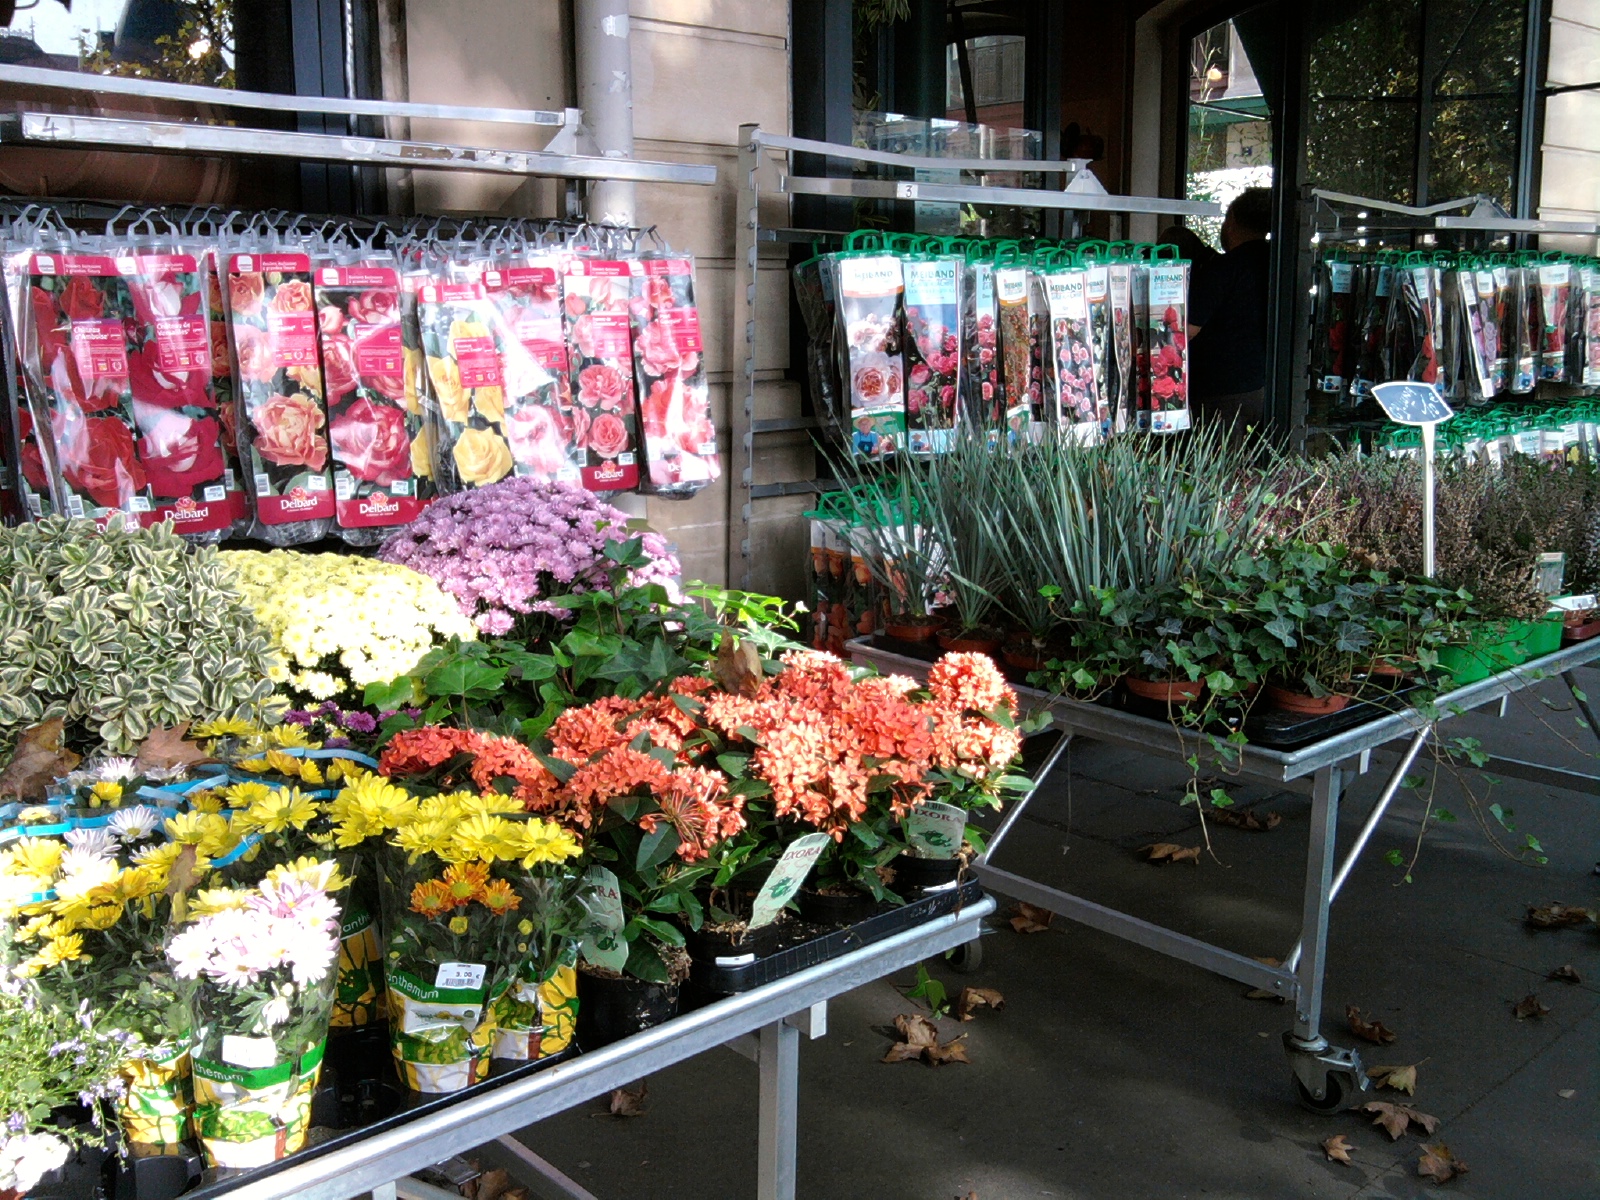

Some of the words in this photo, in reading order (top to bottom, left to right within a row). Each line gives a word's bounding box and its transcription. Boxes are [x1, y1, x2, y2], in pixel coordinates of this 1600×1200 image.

[905, 185, 913, 198] 3
[594, 468, 624, 480] Delbard
[281, 496, 318, 510] Delbard
[359, 501, 399, 514] Delbard
[164, 506, 209, 520] Delbard
[913, 808, 962, 823] IXORA
[782, 846, 823, 861] IXORA
